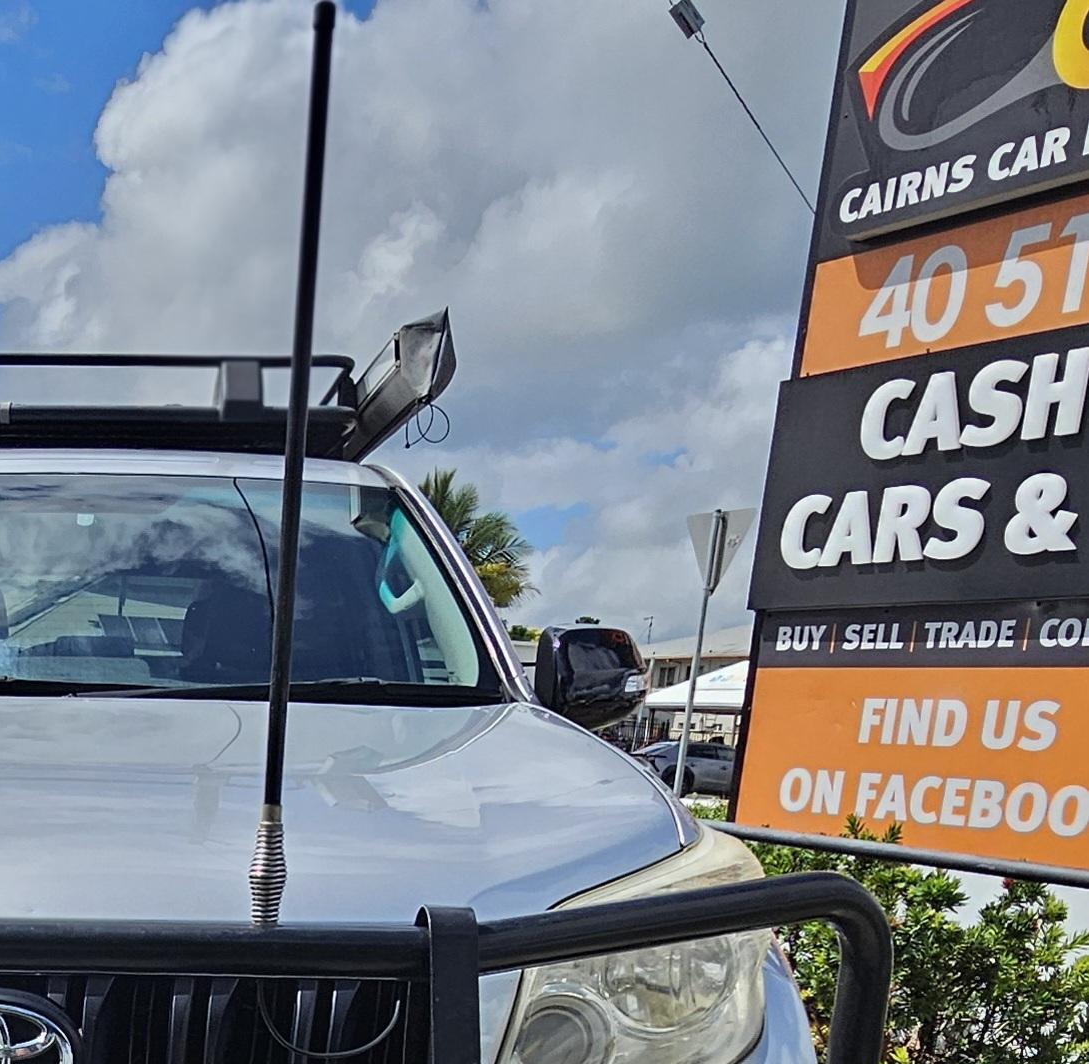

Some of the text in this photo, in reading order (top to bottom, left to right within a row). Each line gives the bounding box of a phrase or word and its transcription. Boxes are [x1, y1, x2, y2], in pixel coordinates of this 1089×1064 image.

[839, 154, 976, 223] CAIRNS
[987, 126, 1071, 181] CAR
[858, 212, 1089, 349] 40 51
[860, 346, 1089, 460] CASH
[780, 472, 1079, 569] CARS &
[775, 625, 827, 651] BUY
[842, 623, 904, 650] SELL
[924, 619, 1016, 648] TRADE
[857, 697, 1061, 751] FIND US
[779, 767, 1089, 837] ON FACEBOO
